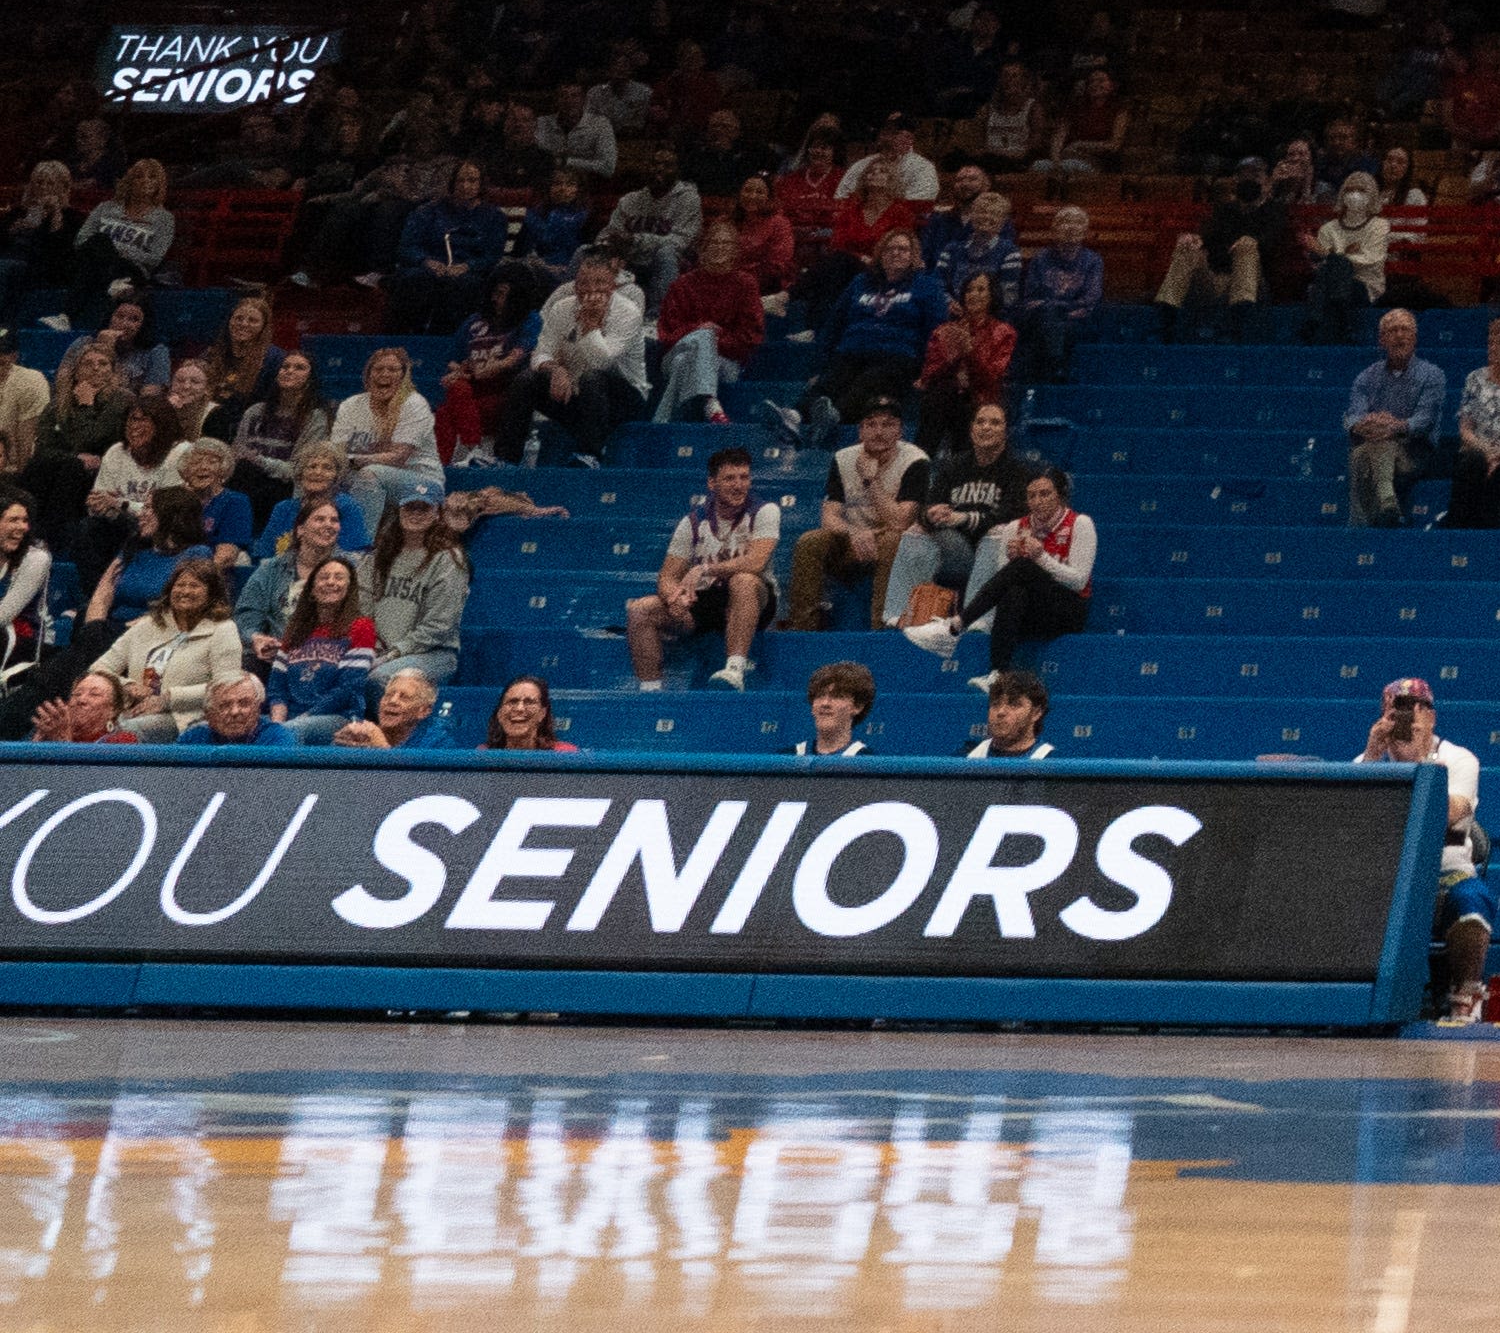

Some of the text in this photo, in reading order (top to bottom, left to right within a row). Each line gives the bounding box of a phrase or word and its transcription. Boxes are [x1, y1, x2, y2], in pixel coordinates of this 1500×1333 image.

[116, 34, 329, 64] THANK YOU
[104, 67, 316, 104] SENIORS
[0, 786, 1203, 941] OU SENIORS
